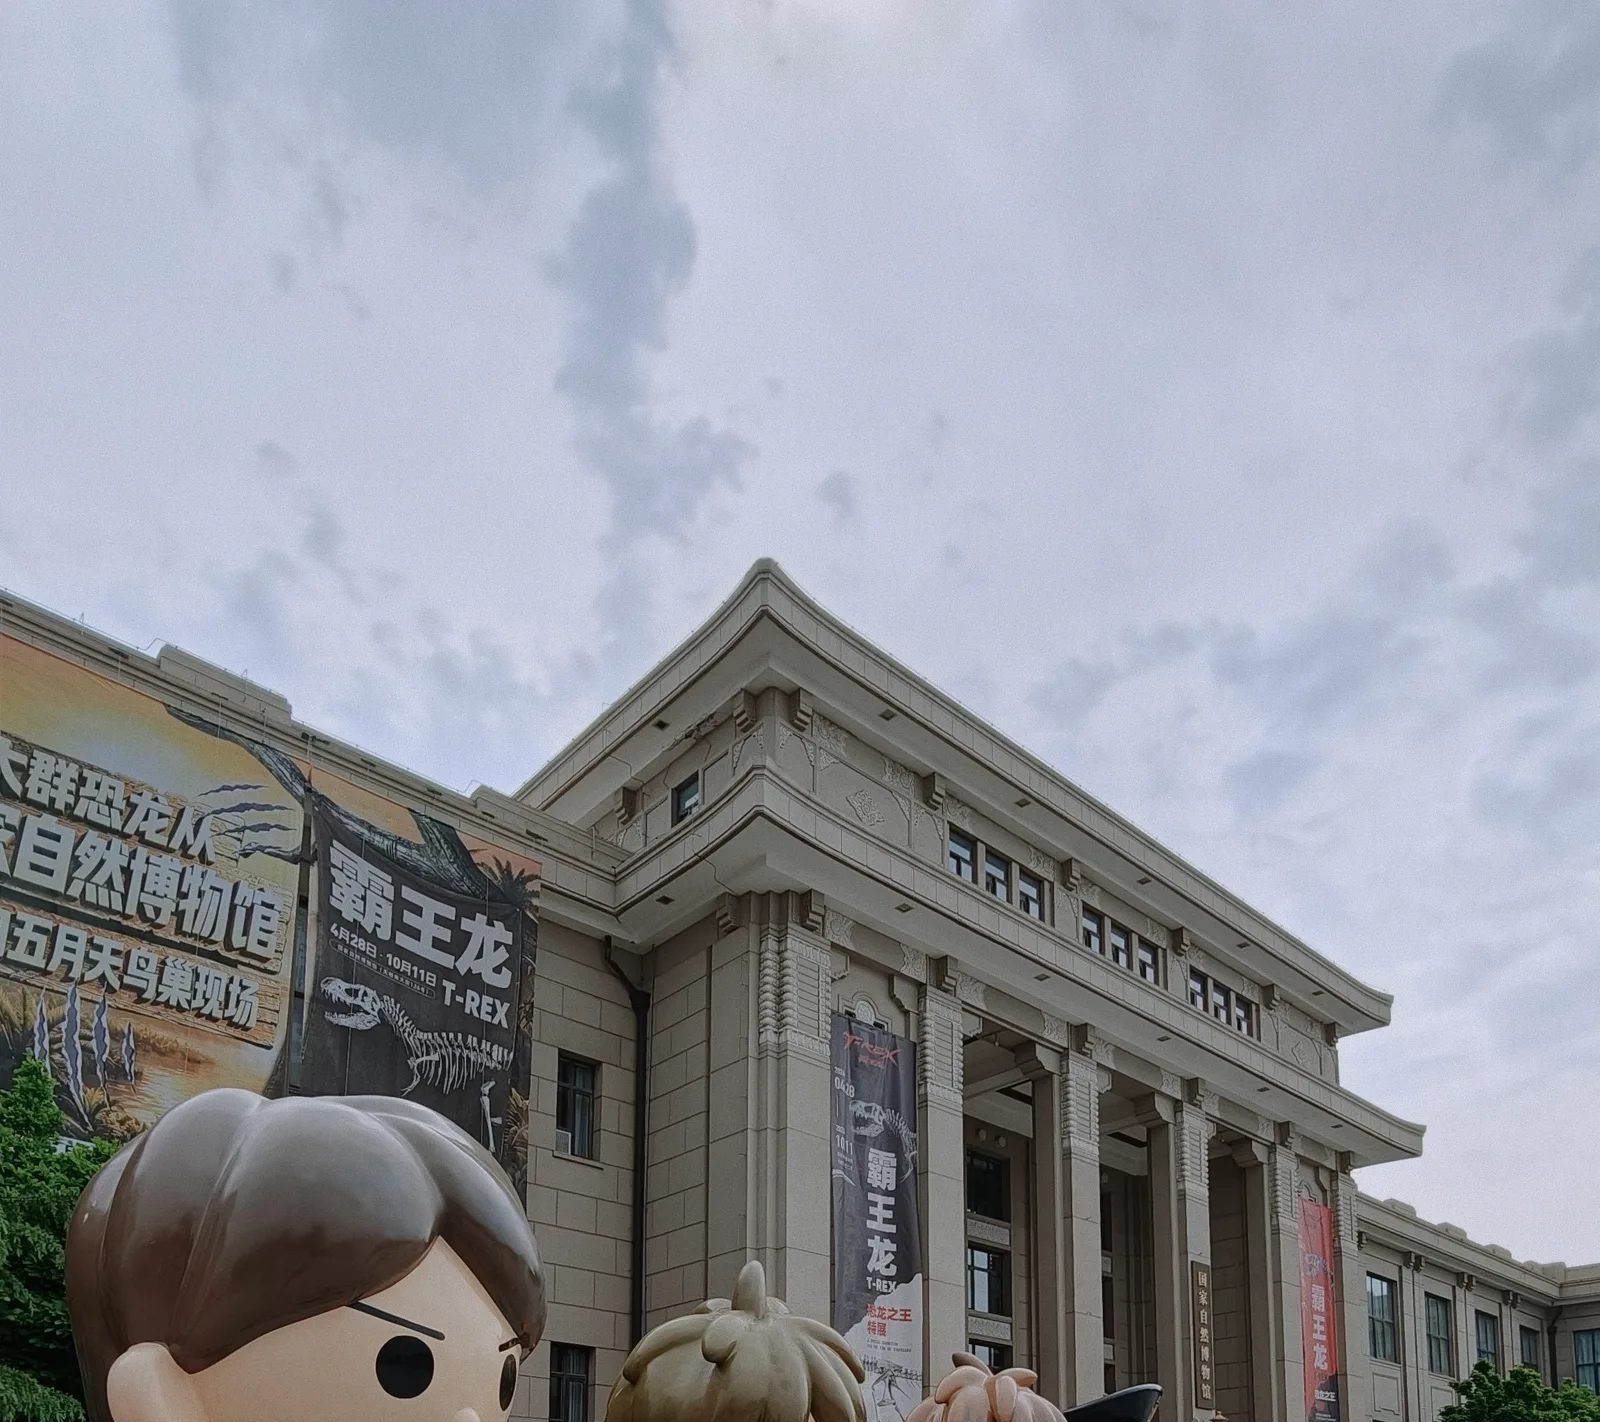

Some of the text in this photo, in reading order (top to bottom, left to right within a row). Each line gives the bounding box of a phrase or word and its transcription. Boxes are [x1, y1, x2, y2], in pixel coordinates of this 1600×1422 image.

[329, 838, 513, 988] 霸王龙
[0, 908, 260, 1028] 五月天鸟巢现场
[330, 922, 437, 987] 4月28日 10月11日
[442, 978, 511, 1029] T-REX
[836, 1134, 853, 1155] 1011
[865, 1147, 897, 1276] 霸王龙
[866, 1276, 897, 1293] T-REX
[866, 1303, 912, 1323] 恐龙之王
[867, 1320, 887, 1337] 特展
[1198, 1271, 1211, 1400] 国家自然博物馆
[1311, 1283, 1328, 1371] 霸王龙
